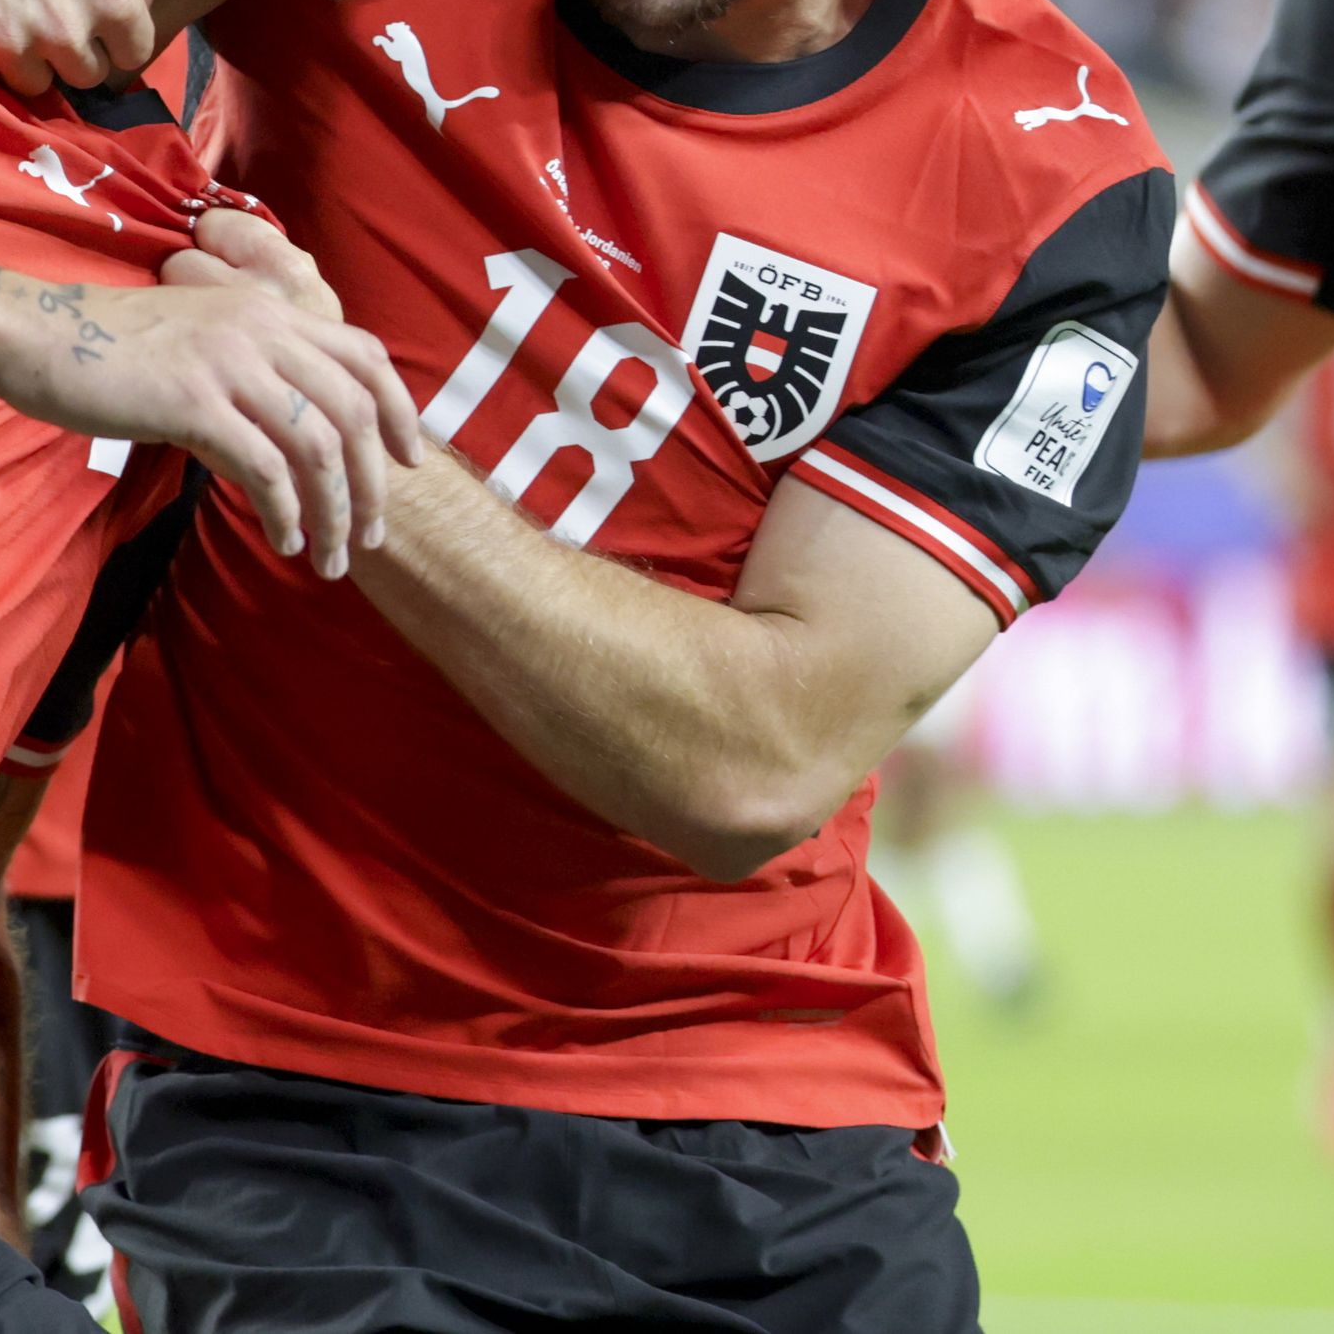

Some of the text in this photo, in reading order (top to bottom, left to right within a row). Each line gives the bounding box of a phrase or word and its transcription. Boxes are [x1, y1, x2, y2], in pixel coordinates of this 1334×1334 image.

[578, 228, 643, 274] Jordanien
[757, 263, 823, 302] ÖFB
[418, 247, 696, 551] 18
